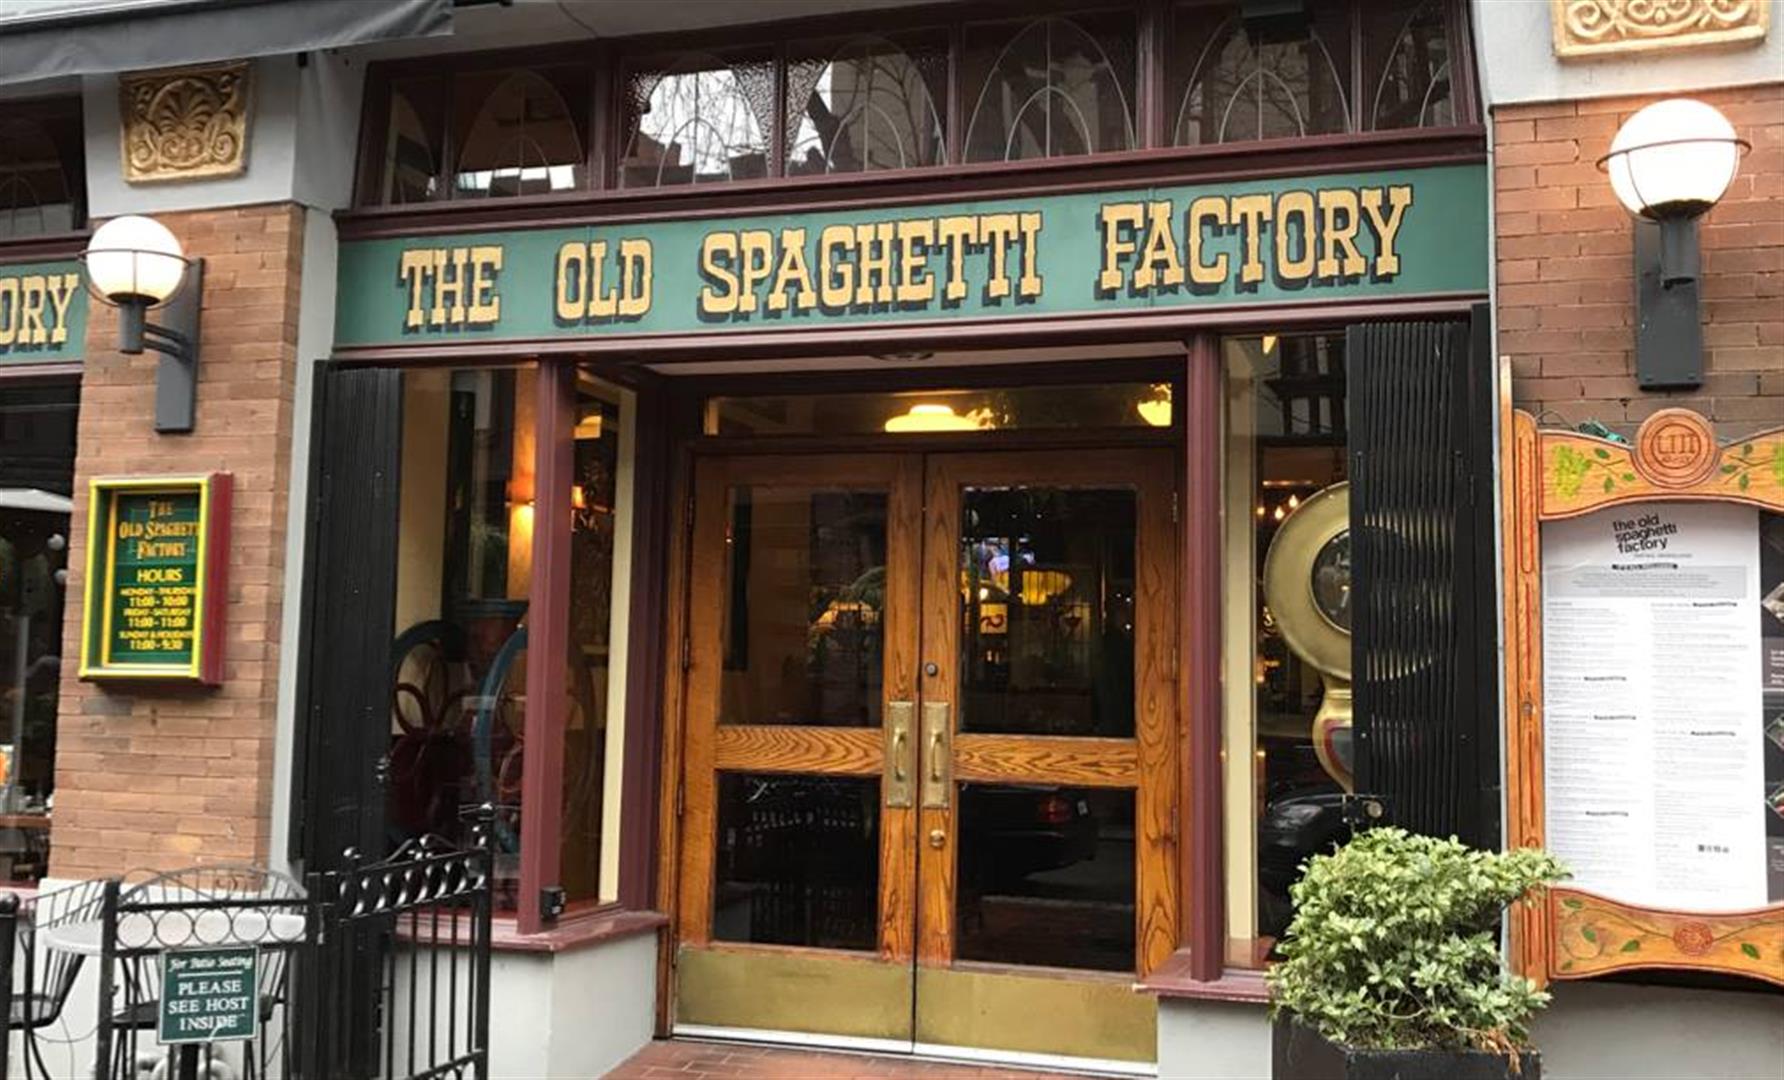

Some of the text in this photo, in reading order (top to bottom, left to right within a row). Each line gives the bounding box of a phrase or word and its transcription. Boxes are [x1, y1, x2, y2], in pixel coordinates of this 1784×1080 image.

[400, 184, 1414, 329] THE OLD SPAGHETTI FACTORY
[119, 520, 201, 540] OLD SPAGHETT
[1612, 513, 1660, 532] the old
[1614, 523, 1678, 543] spaghetti
[136, 541, 186, 560] FACTORY
[1617, 537, 1668, 554] factory
[137, 569, 182, 582] HOURS
[120, 587, 155, 597] MONDAY
[129, 618, 154, 628] 11:00
[161, 617, 187, 628] 11:00
[130, 640, 156, 650] 11:00
[217, 956, 253, 970] Seating
[177, 979, 243, 996] PLEASE
[167, 996, 250, 1015] SEE HOST
[179, 1014, 238, 1032] INSIDE
